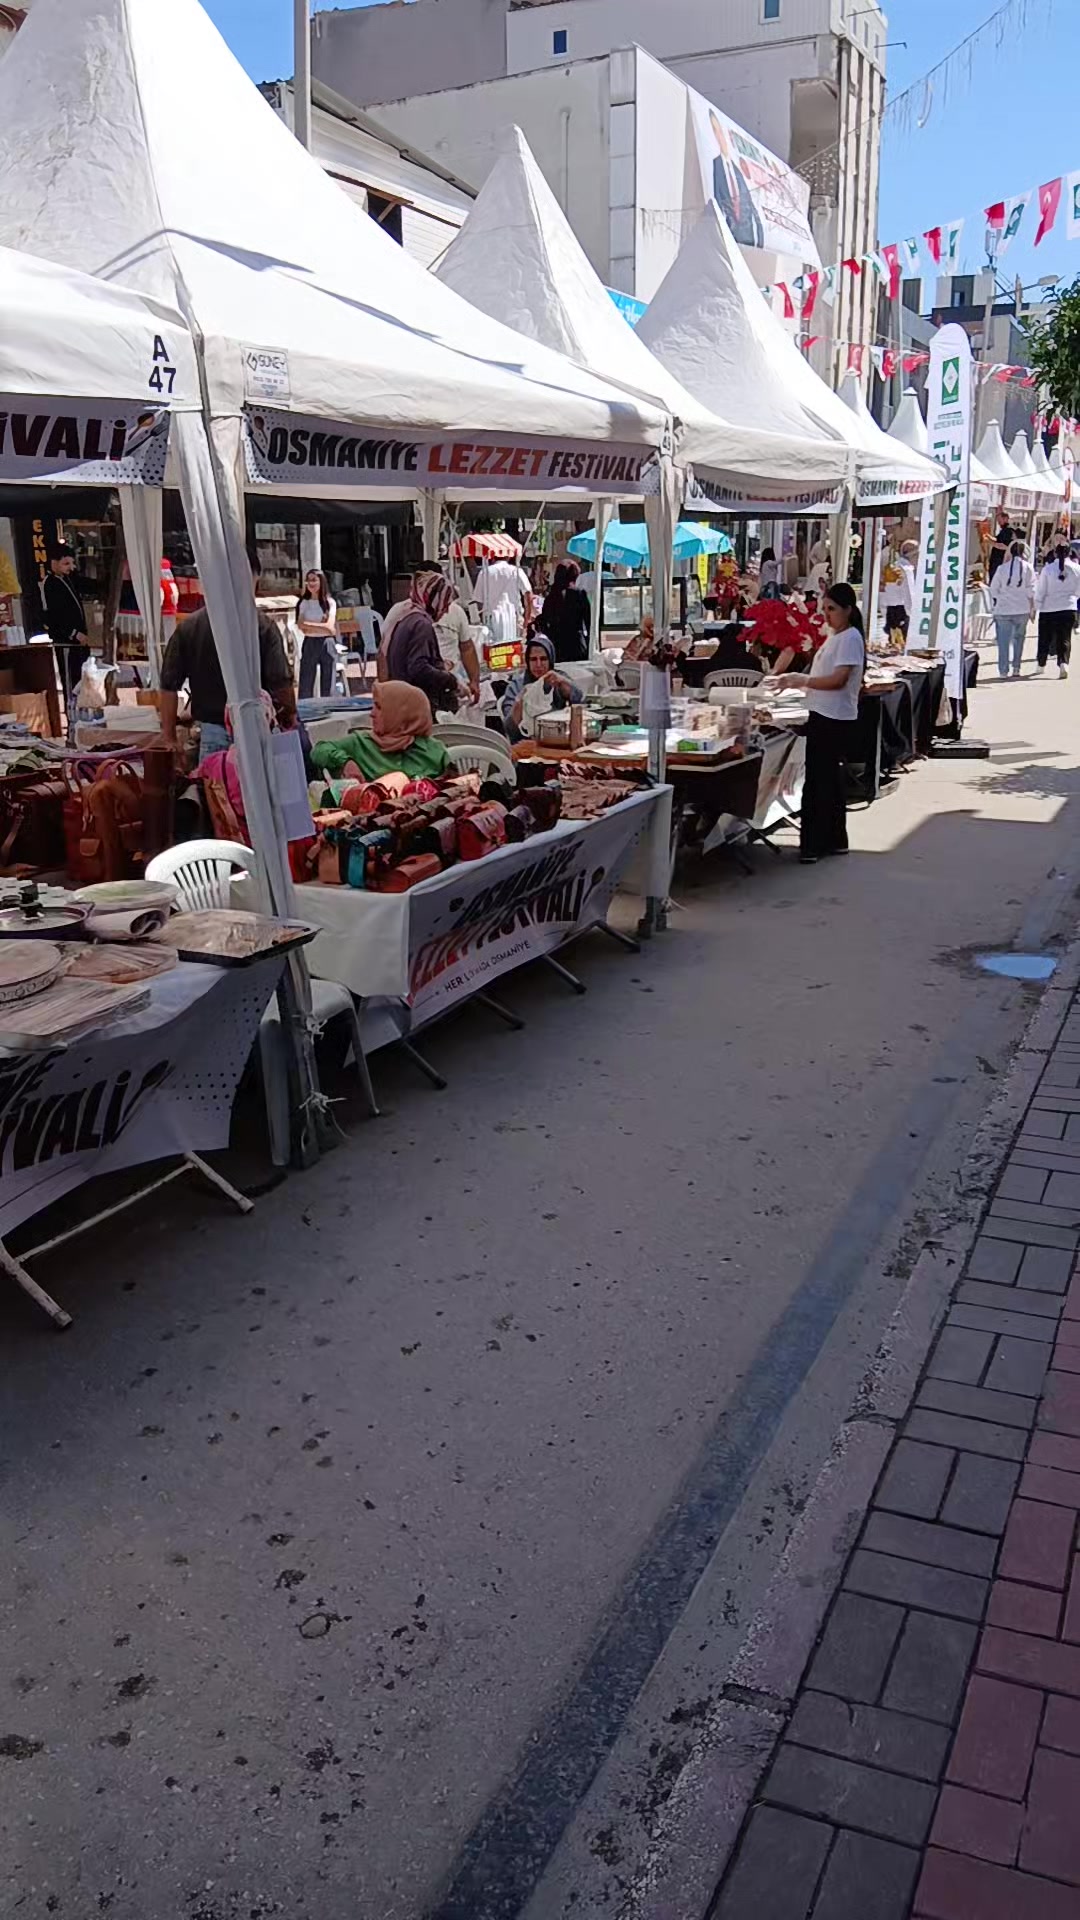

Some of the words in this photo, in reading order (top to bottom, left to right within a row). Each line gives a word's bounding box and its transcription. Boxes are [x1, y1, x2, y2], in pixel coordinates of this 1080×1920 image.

[152, 334, 170, 363] A
[148, 366, 177, 393] 47
[267, 427, 425, 471] OSMANİYE
[428, 442, 549, 477] LEZZET
[547, 451, 643, 482] FESTİVALİ
[444, 976, 465, 993] HER
[490, 940, 532, 966] OSMANİYE
